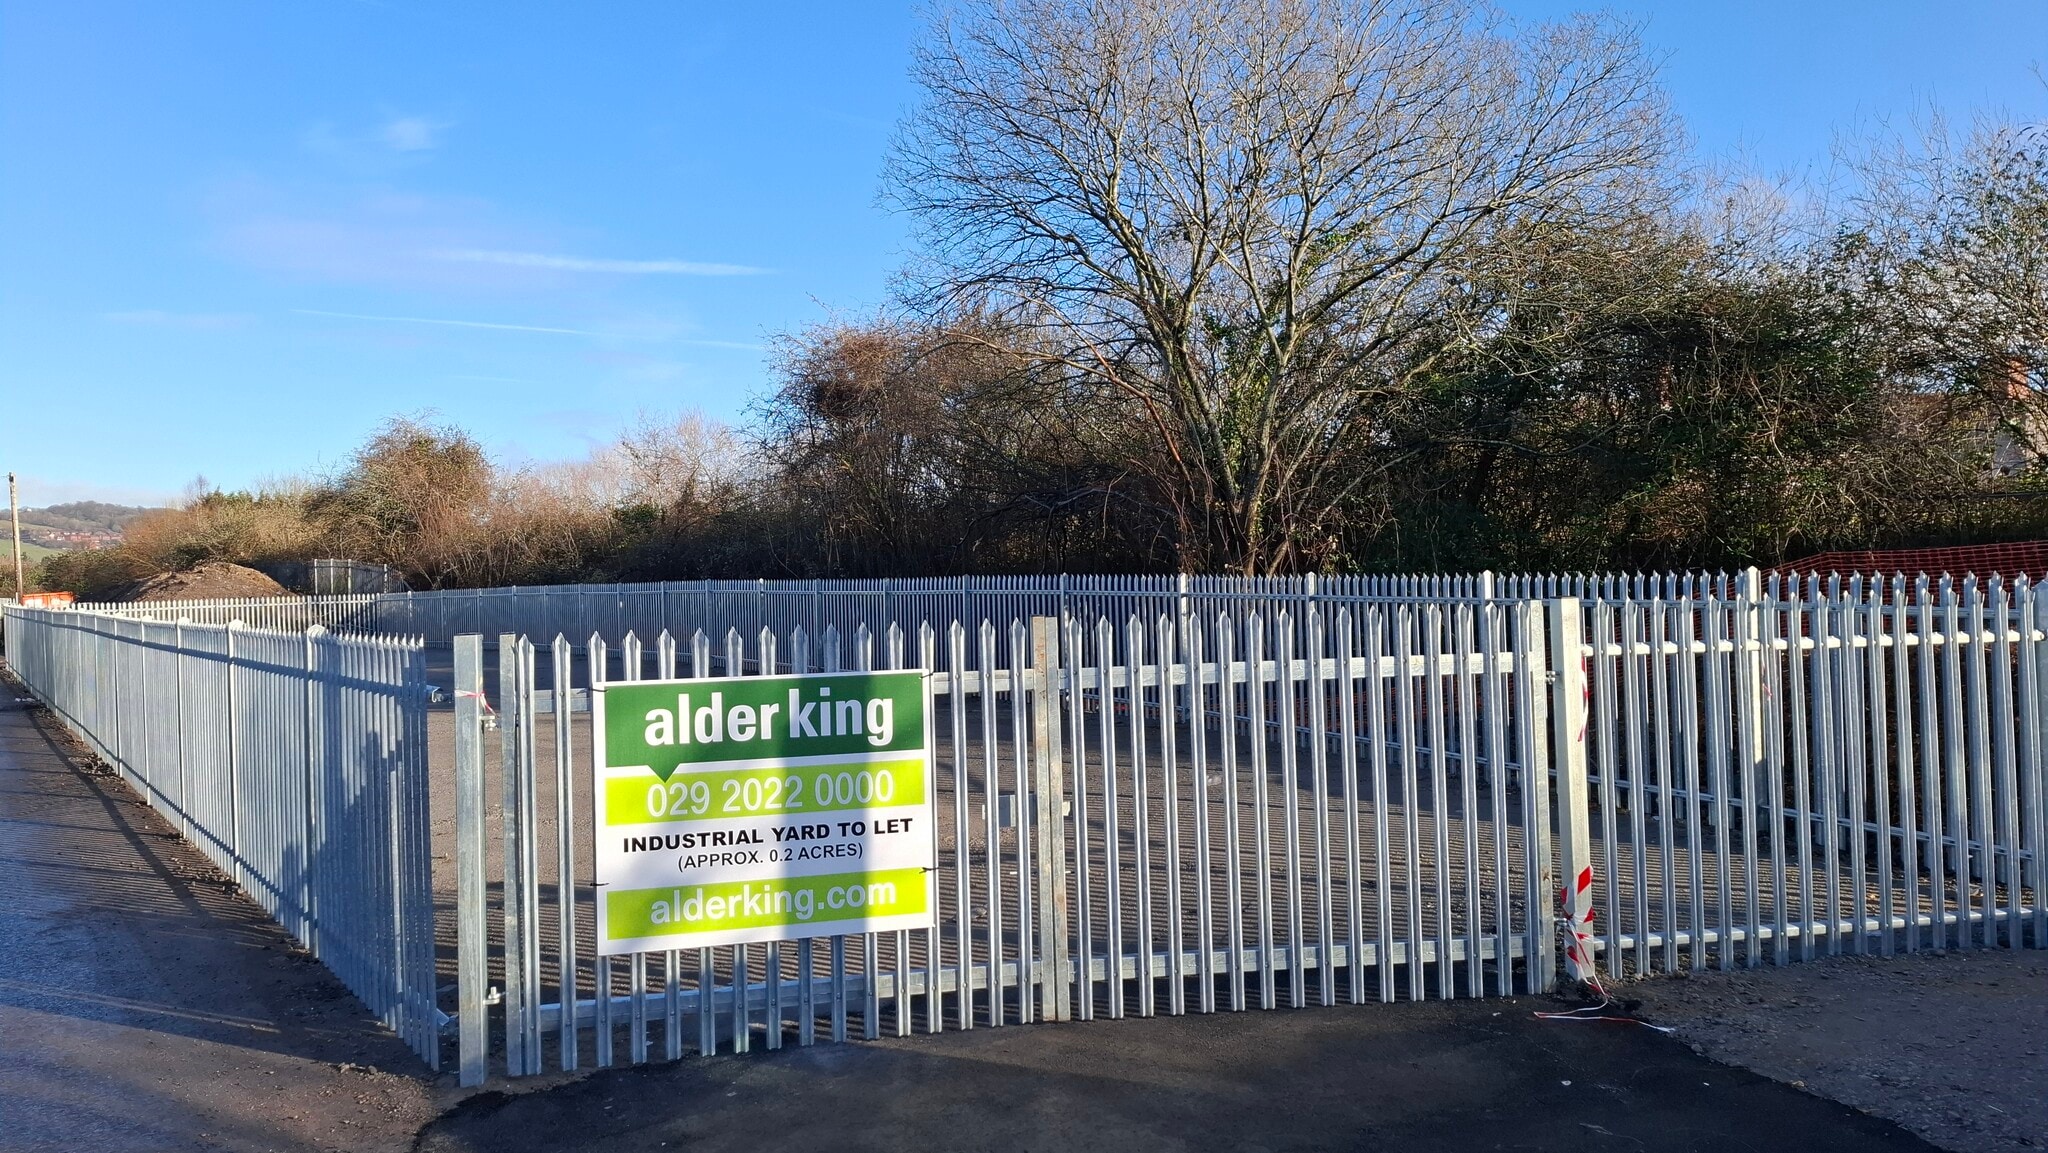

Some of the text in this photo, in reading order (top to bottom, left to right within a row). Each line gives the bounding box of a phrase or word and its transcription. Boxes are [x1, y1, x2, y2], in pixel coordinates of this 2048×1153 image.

[644, 687, 894, 747] alder king
[647, 770, 894, 818] 029 2022 0000
[623, 818, 913, 853] INDUSTRIAL YARD TO LET
[677, 843, 864, 872] (APPROX. 0.2 ACRES)
[650, 881, 896, 924] alderking.com
